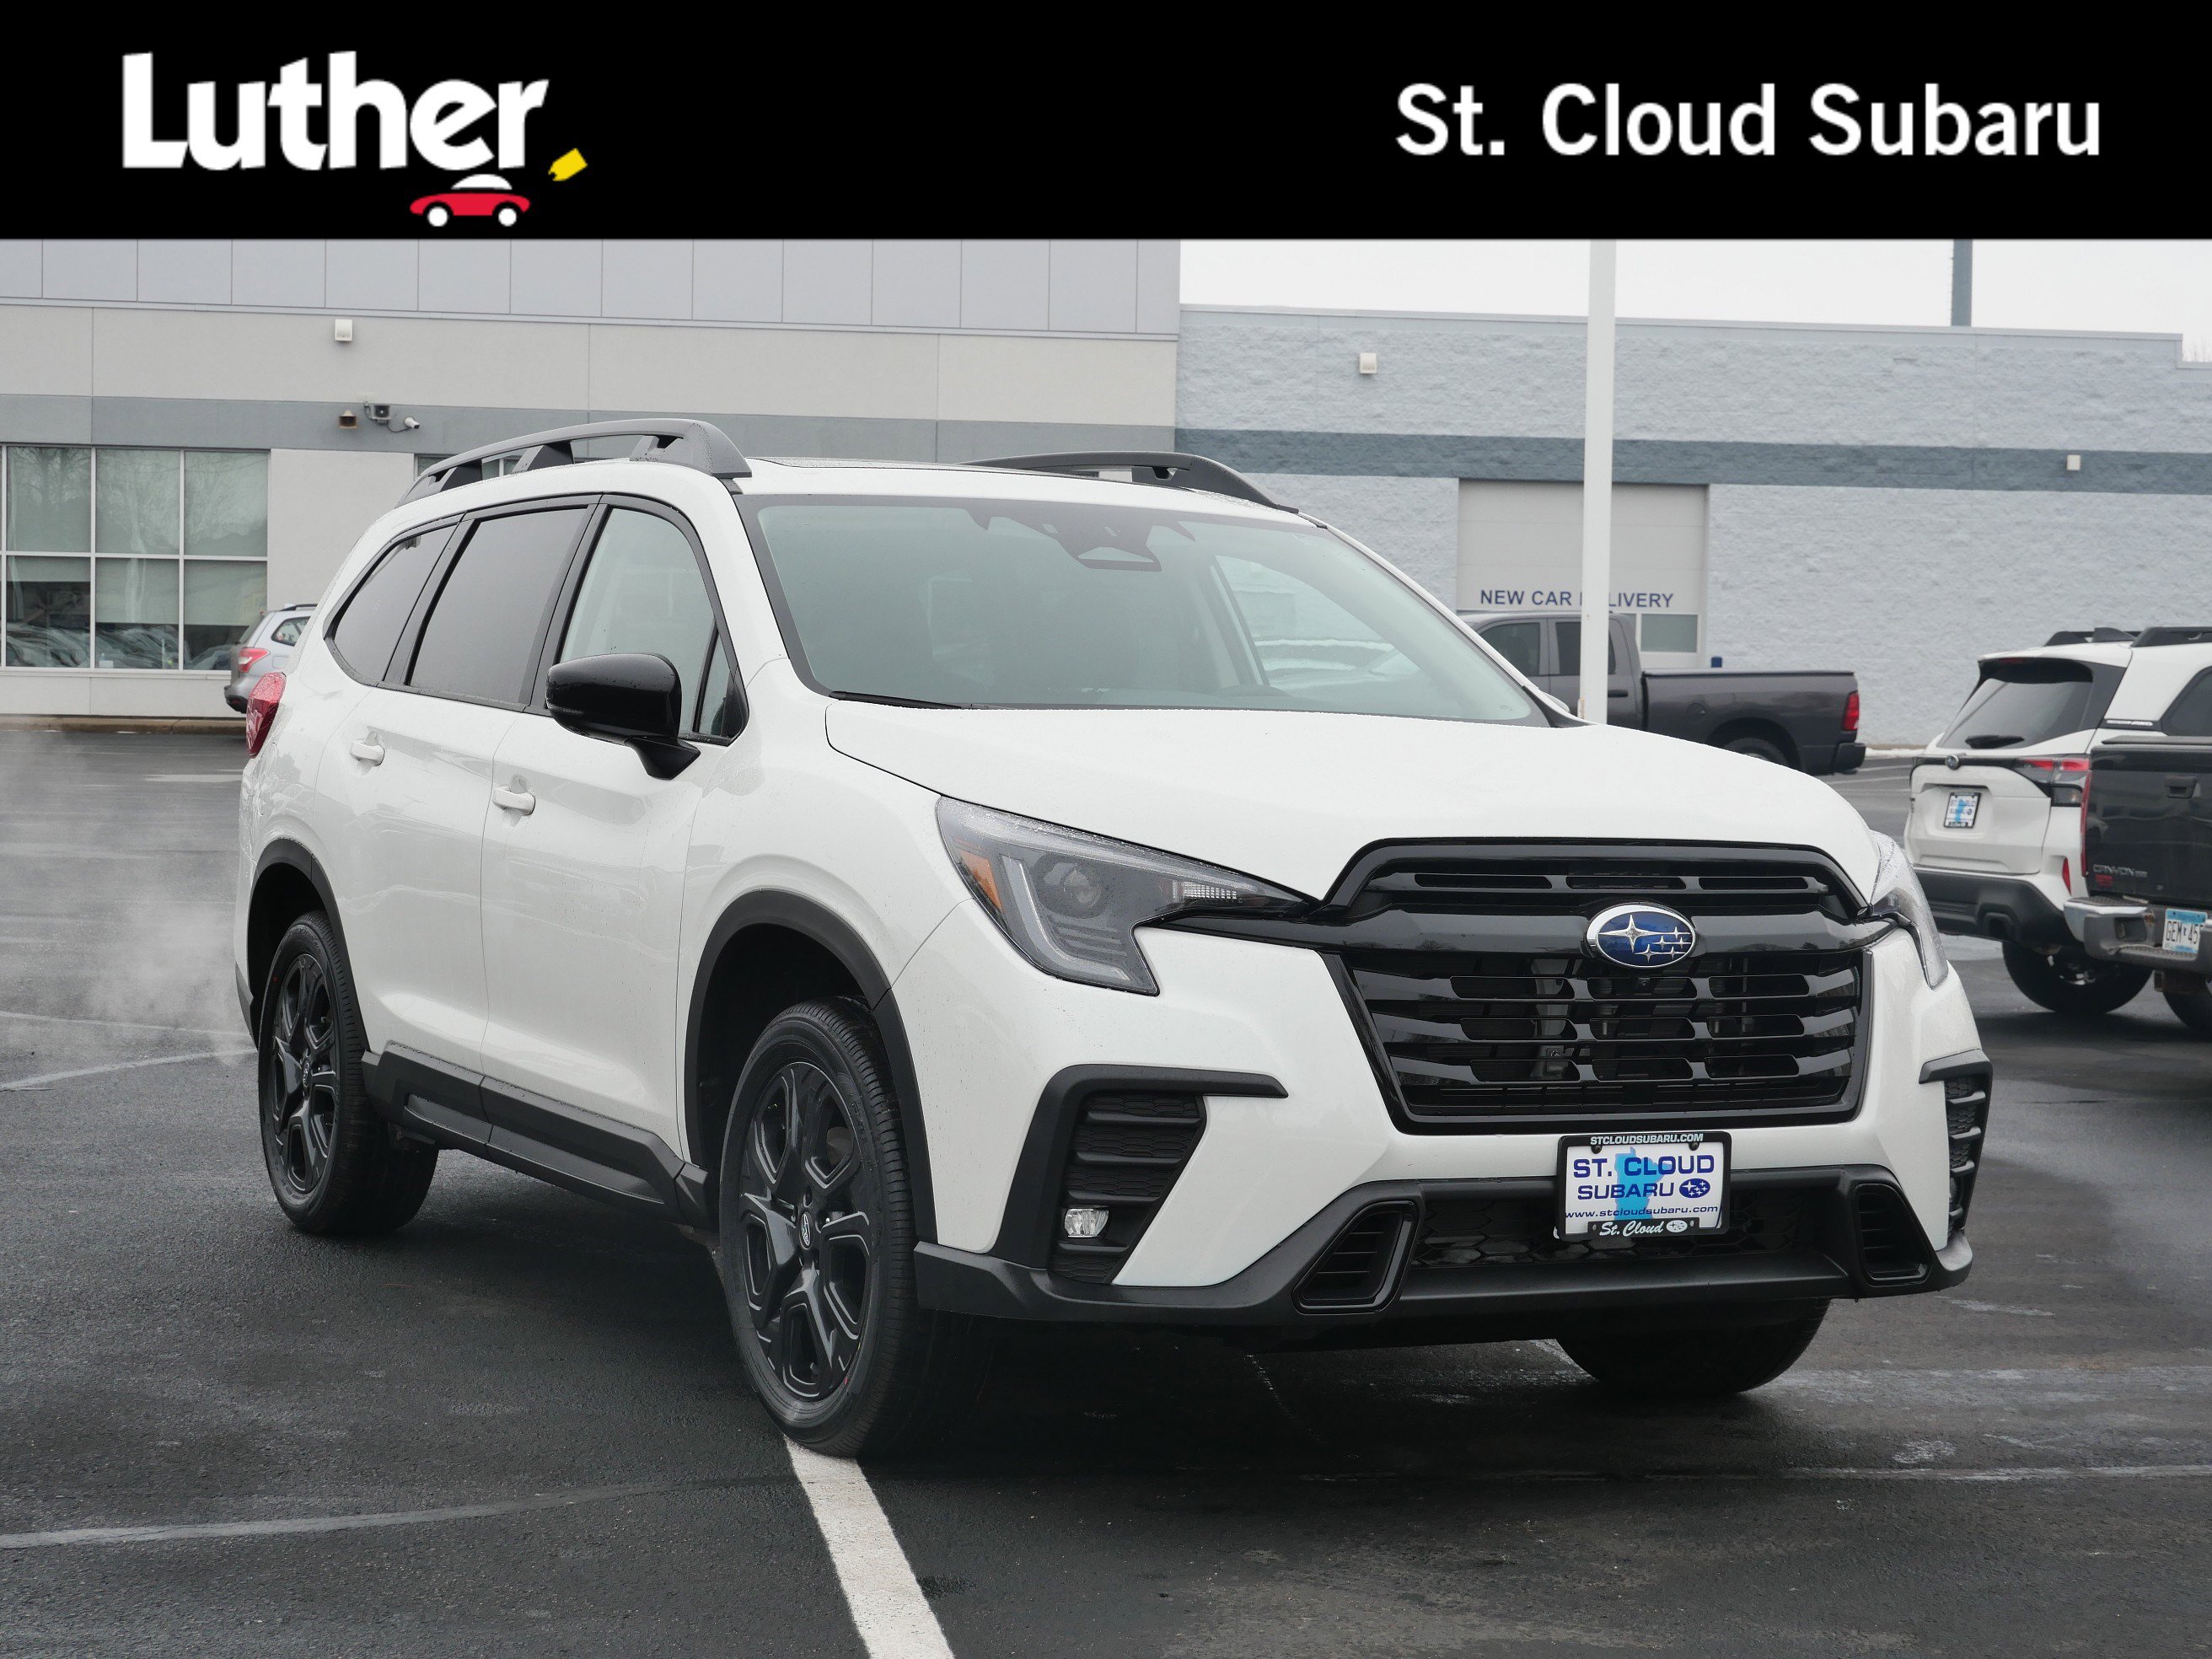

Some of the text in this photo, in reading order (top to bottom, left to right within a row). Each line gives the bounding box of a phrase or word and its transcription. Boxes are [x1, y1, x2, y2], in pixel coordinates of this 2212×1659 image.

[1480, 589, 1674, 608] NEW CAR LIVERY
[2188, 923, 2204, 945] 45
[1590, 1133, 1704, 1146] STCLOUDSUBARU.COM
[1573, 1154, 1715, 1178] ST. CLOUD
[1577, 1182, 1674, 1200] SUBARU
[1565, 1205, 1718, 1218] www.stcloudsubaru.com
[1599, 1220, 1665, 1237] St. Cloud
